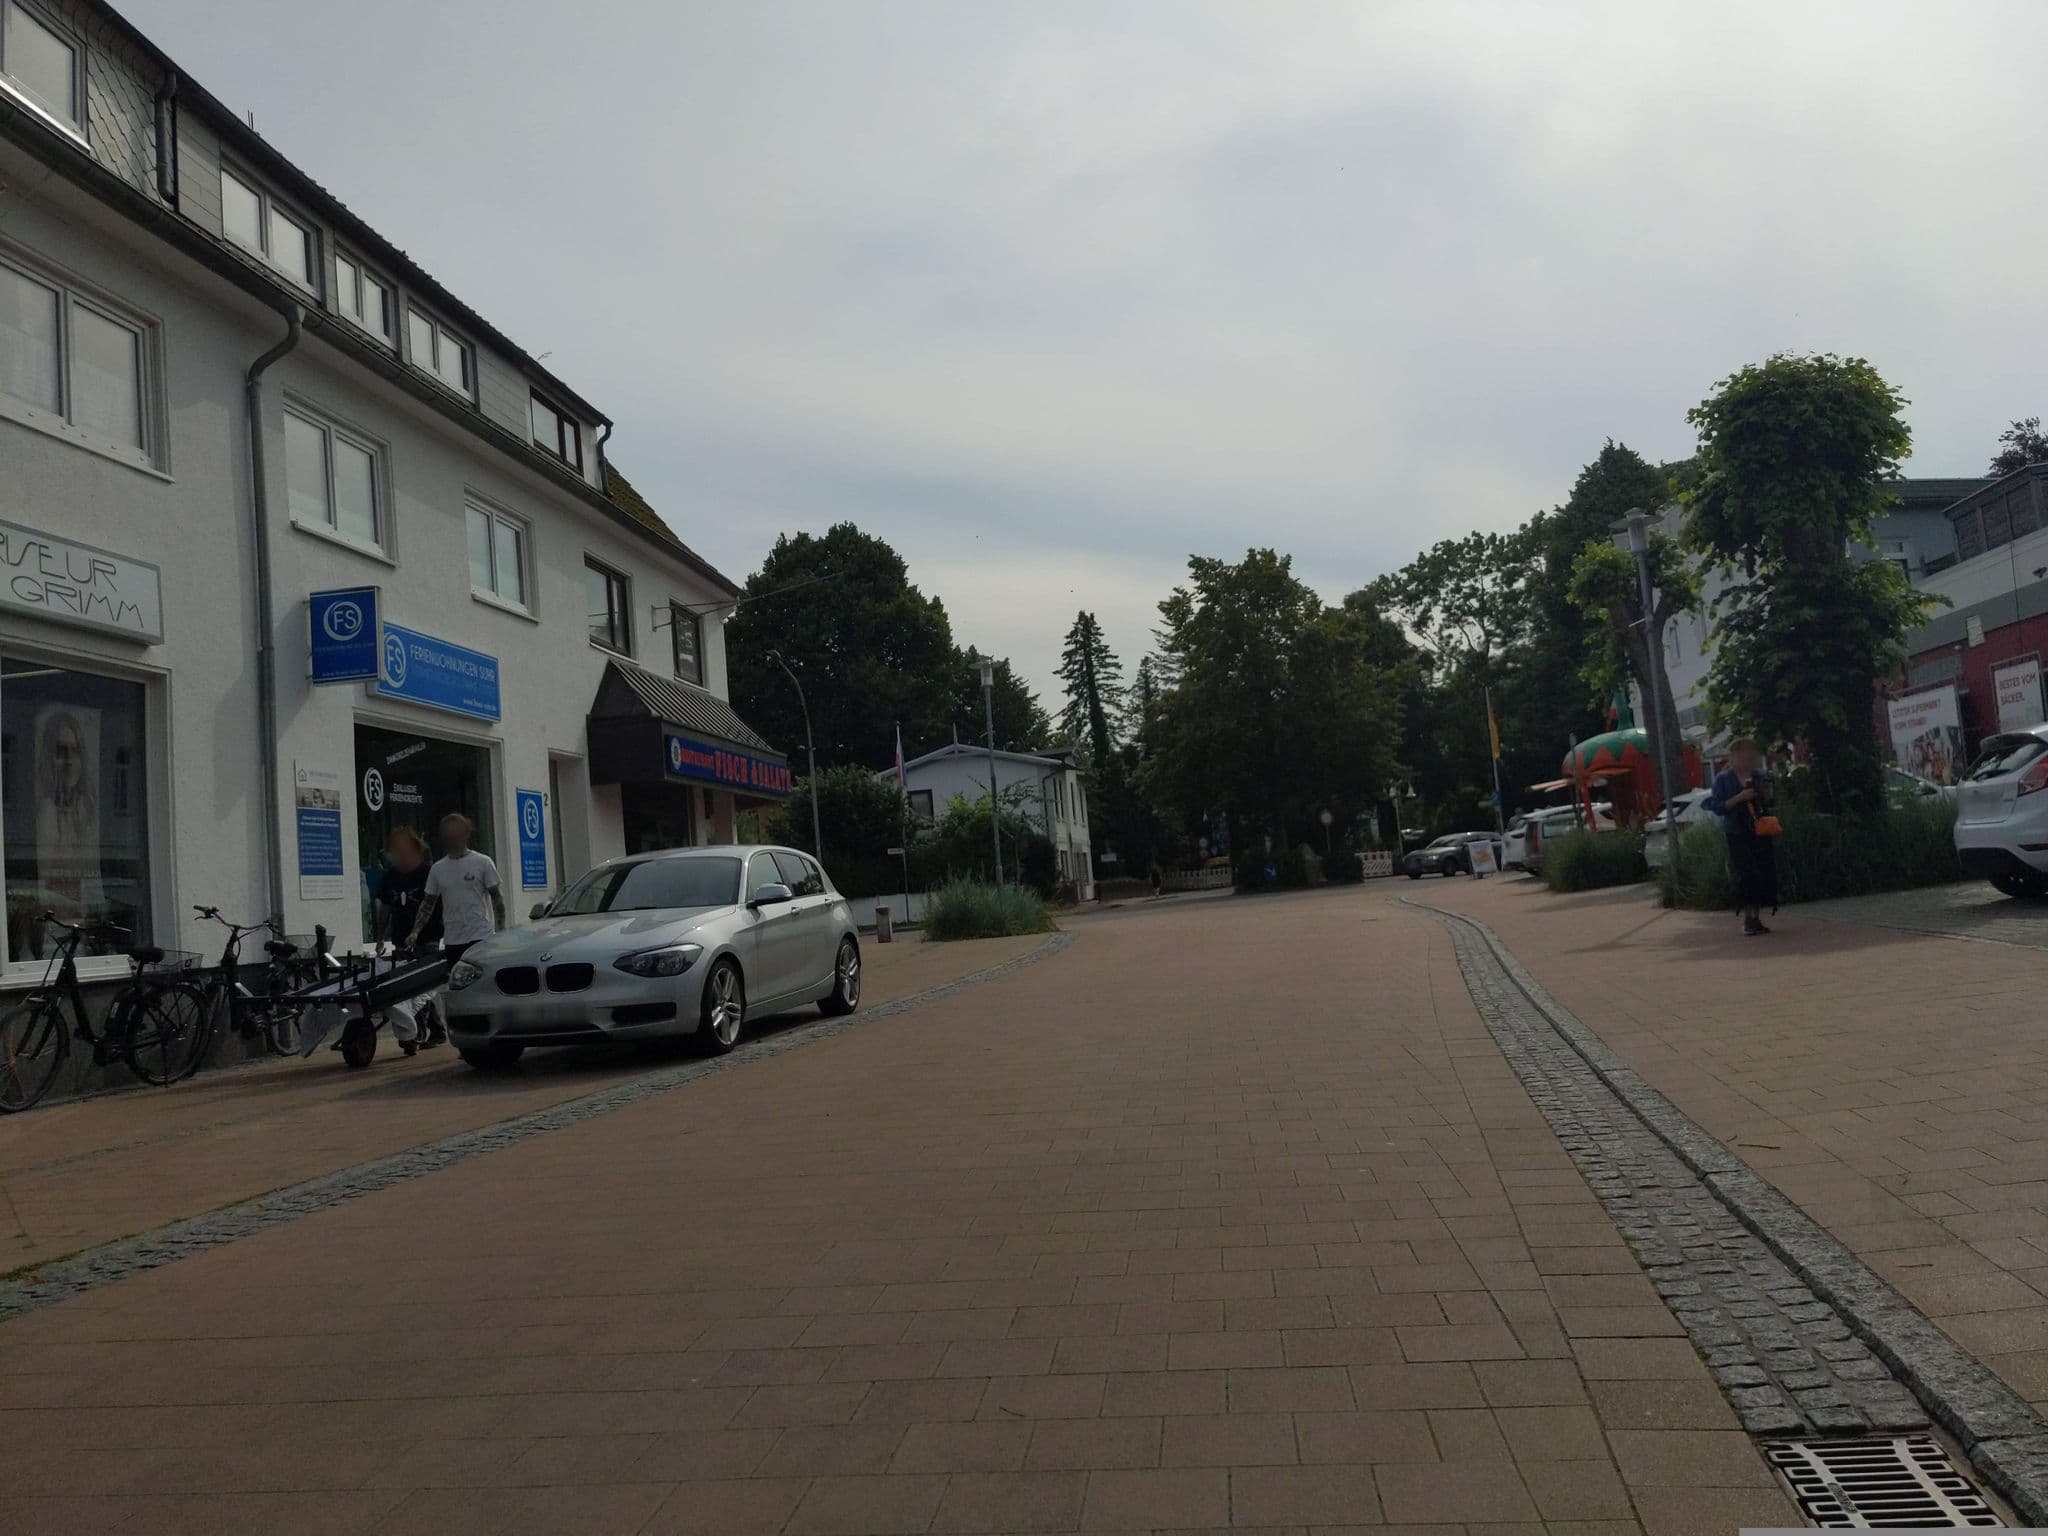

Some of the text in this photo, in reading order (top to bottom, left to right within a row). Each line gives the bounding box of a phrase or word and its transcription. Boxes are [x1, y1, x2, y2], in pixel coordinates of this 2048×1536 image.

[11, 576, 144, 629] GRIMM
[333, 609, 357, 632] FS
[543, 793, 549, 806] 2
